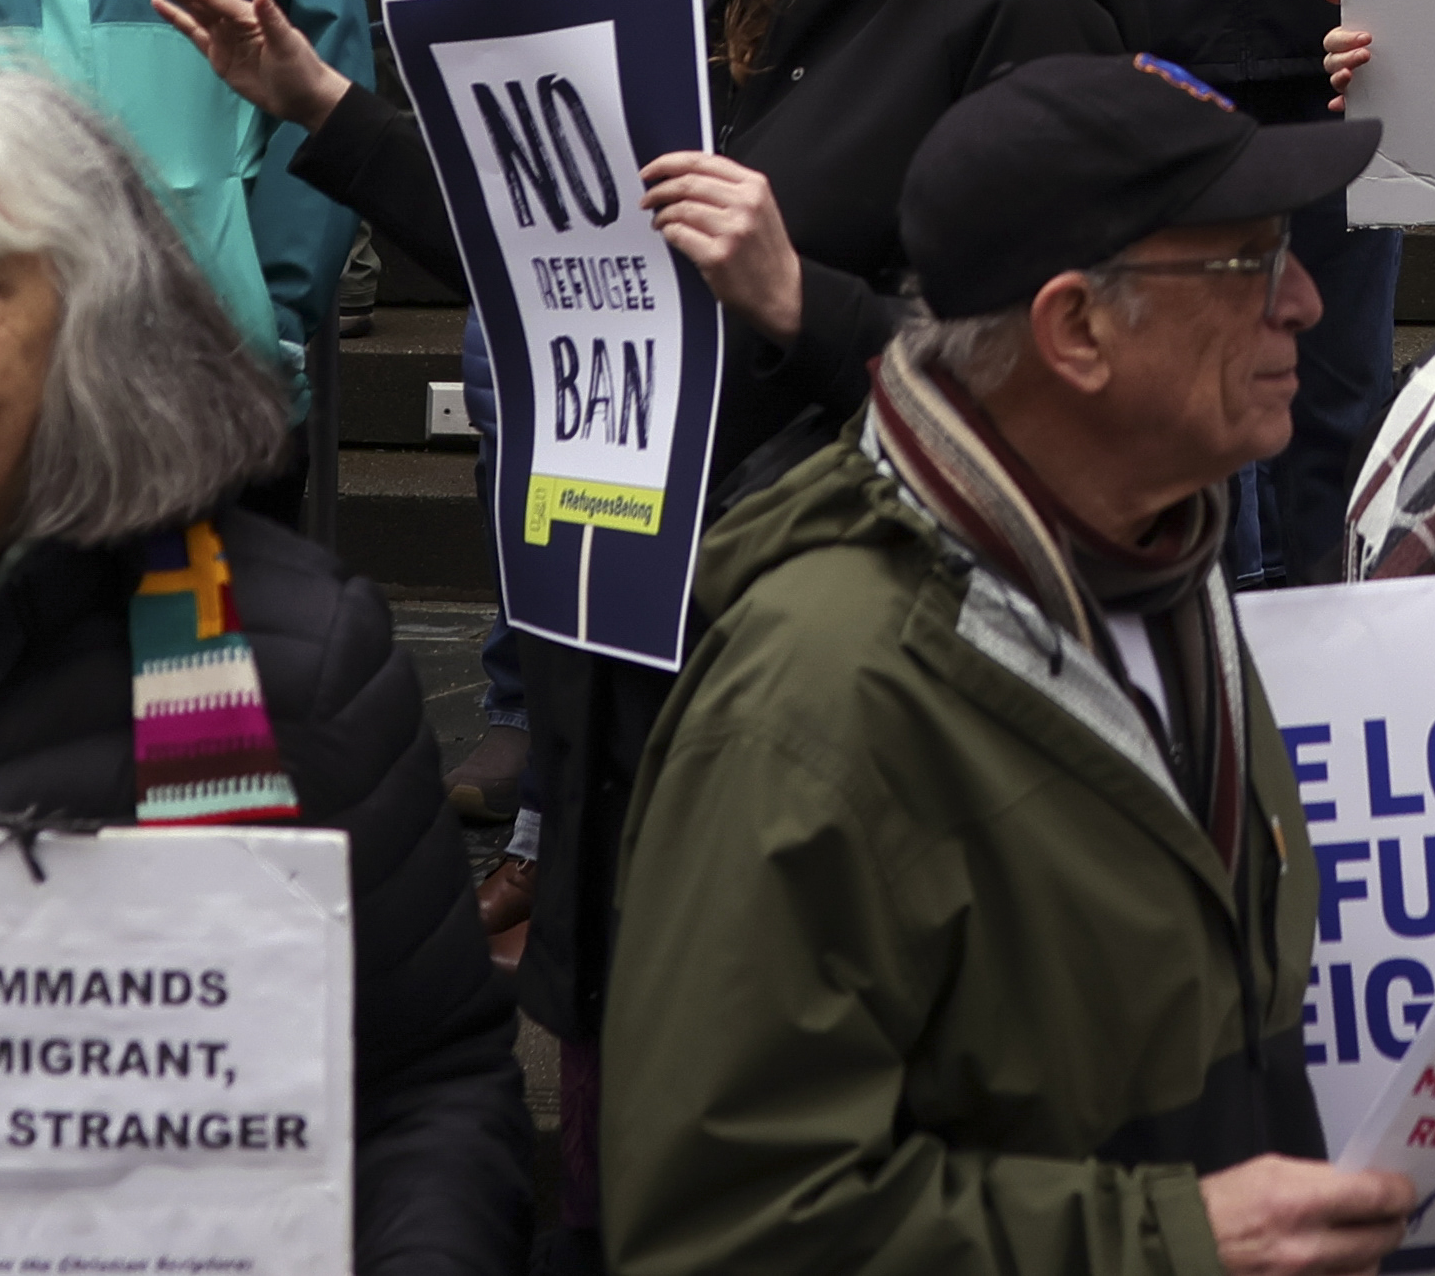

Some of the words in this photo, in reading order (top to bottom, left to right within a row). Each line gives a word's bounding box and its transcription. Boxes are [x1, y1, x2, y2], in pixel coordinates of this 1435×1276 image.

[471, 72, 620, 233] NO
[531, 255, 656, 312] REFUGEE
[550, 334, 656, 451] BAN
[559, 488, 654, 528] #RefugeesBelong
[7, 1110, 309, 1151] STRANGER
